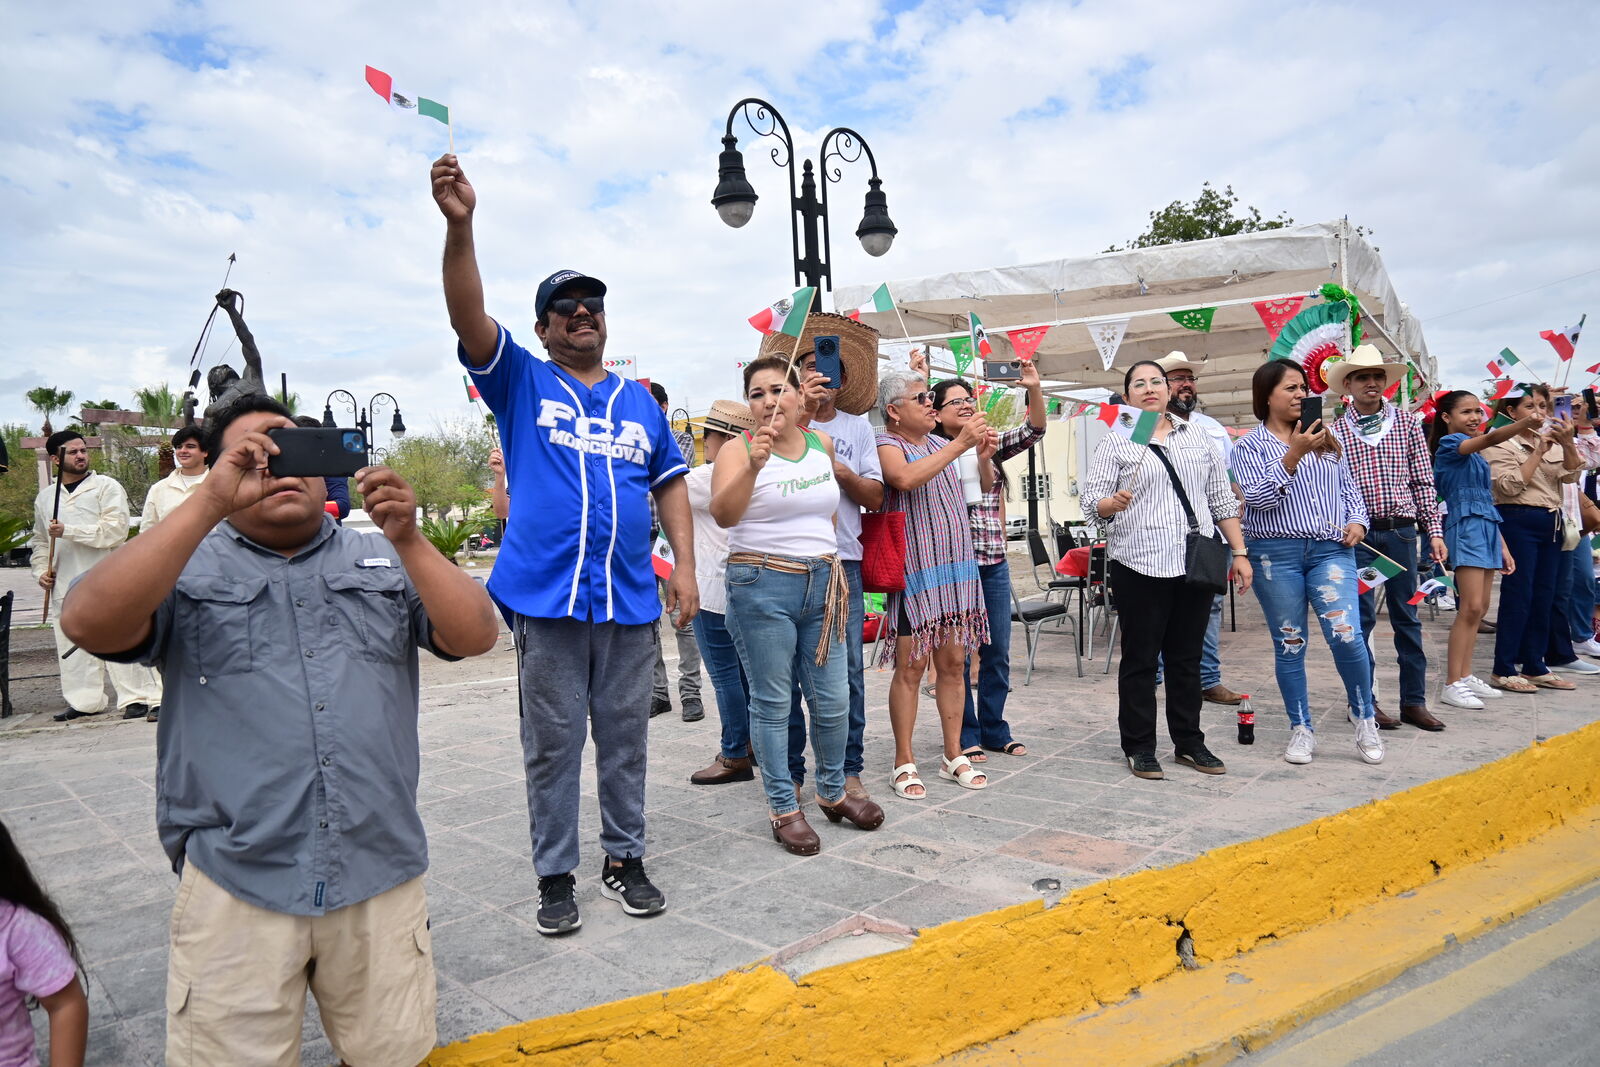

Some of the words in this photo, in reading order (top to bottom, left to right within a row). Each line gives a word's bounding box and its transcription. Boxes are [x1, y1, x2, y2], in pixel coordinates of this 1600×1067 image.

[536, 398, 652, 454] FCA
[549, 428, 645, 465] MONCLOVA
[831, 436, 853, 461] CA
